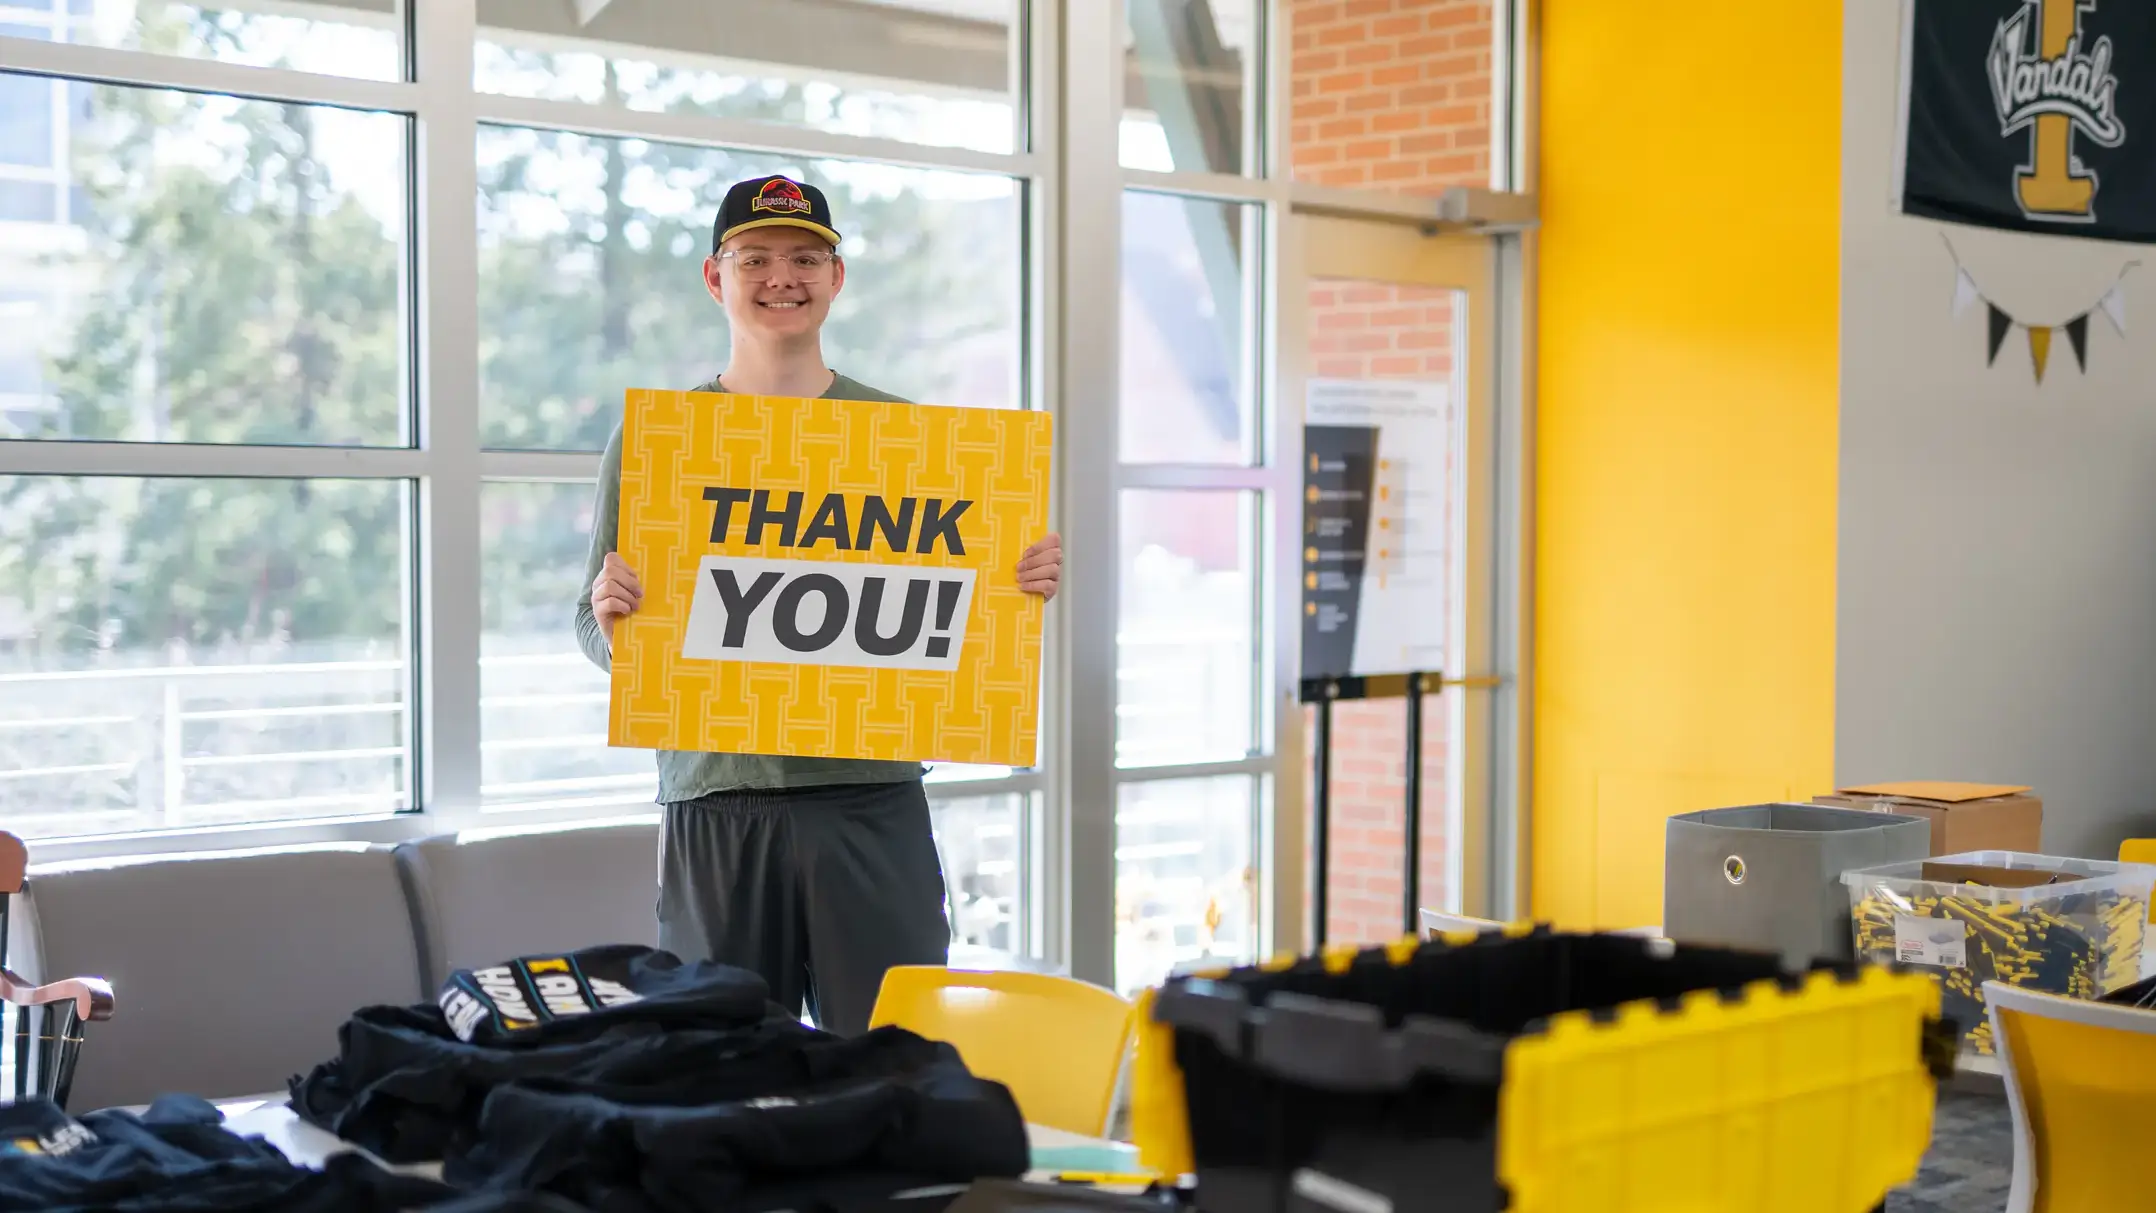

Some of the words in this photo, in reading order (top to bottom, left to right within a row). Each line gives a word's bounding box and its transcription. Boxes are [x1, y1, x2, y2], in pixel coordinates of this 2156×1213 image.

[1988, 4, 2121, 140] Vandals
[755, 197, 788, 209] JURASSIC
[788, 198, 809, 210] PARK
[702, 487, 974, 555] THANK
[710, 568, 963, 658] YOU!
[473, 967, 538, 1021] HOW
